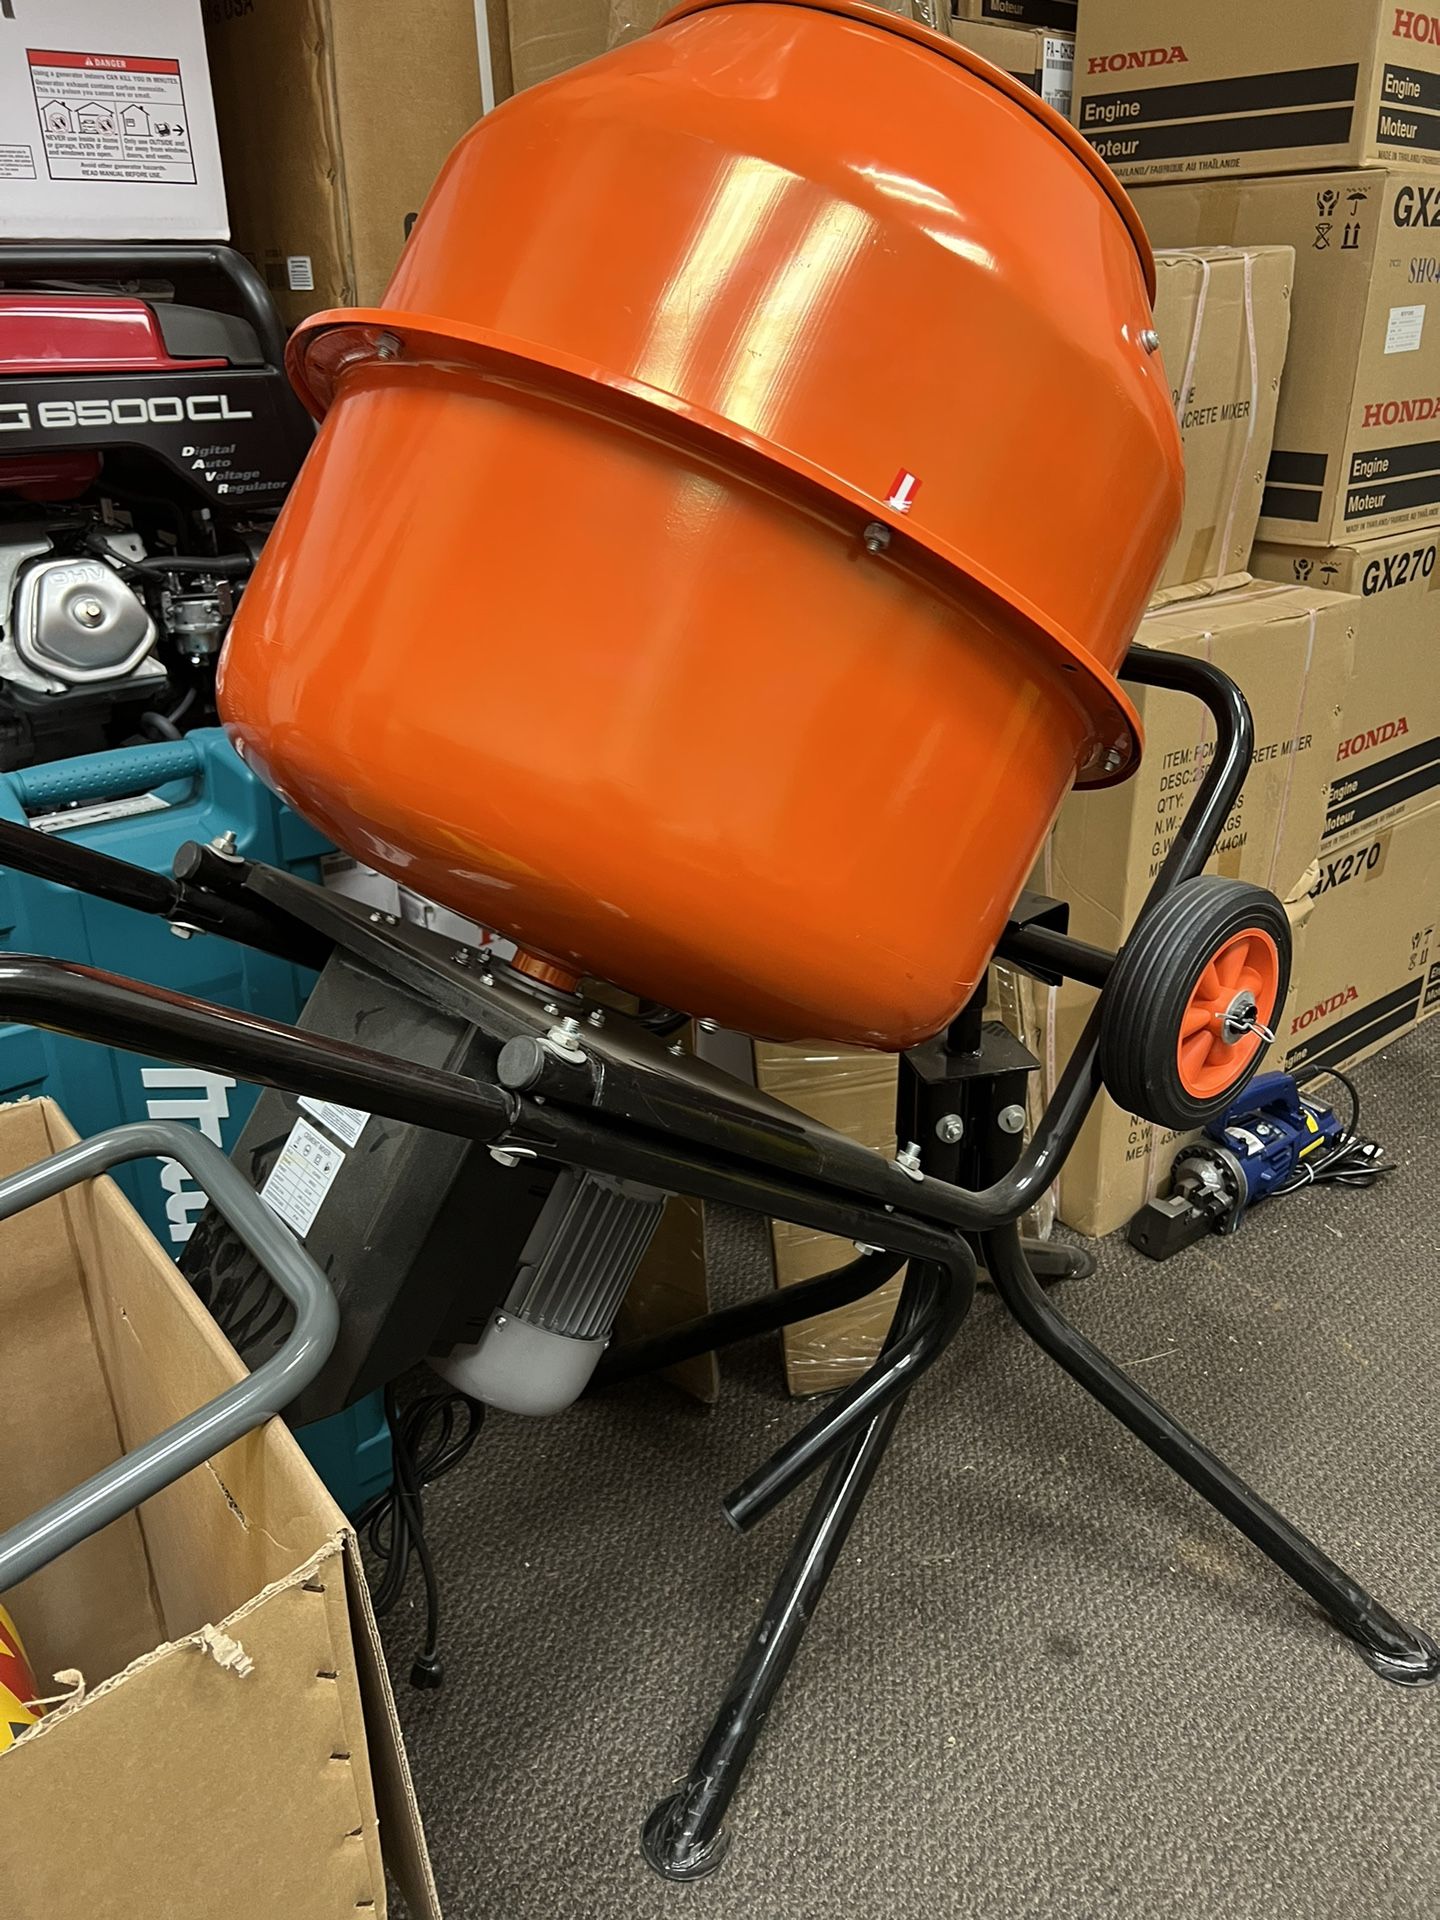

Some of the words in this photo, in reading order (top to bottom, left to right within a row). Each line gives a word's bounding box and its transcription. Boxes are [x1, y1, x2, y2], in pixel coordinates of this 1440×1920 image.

[991, 0, 1024, 15] Moteur
[95, 58, 126, 68] DANGER
[1087, 45, 1189, 75] HONDA
[1384, 73, 1421, 100] Engine
[1084, 100, 1141, 122] Engine
[1380, 115, 1418, 139] Moteur
[1093, 139, 1139, 158] oteur
[1181, 406, 1218, 429] NCRETE
[1220, 401, 1250, 421] MIXER
[181, 444, 236, 457] Digital
[191, 458, 231, 470] Auto
[1352, 457, 1390, 478] Engine
[205, 469, 260, 482] Voltage
[217, 480, 287, 494] Regulator
[1347, 493, 1386, 513] Moteur
[1362, 544, 1436, 597] GX270
[1252, 743, 1278, 764] RETE
[1281, 734, 1312, 756] MIER
[1336, 717, 1409, 762] HONDA
[1163, 748, 1193, 770] ITEM:
[1329, 779, 1358, 801] Engine
[1157, 793, 1184, 813] Q'TY:
